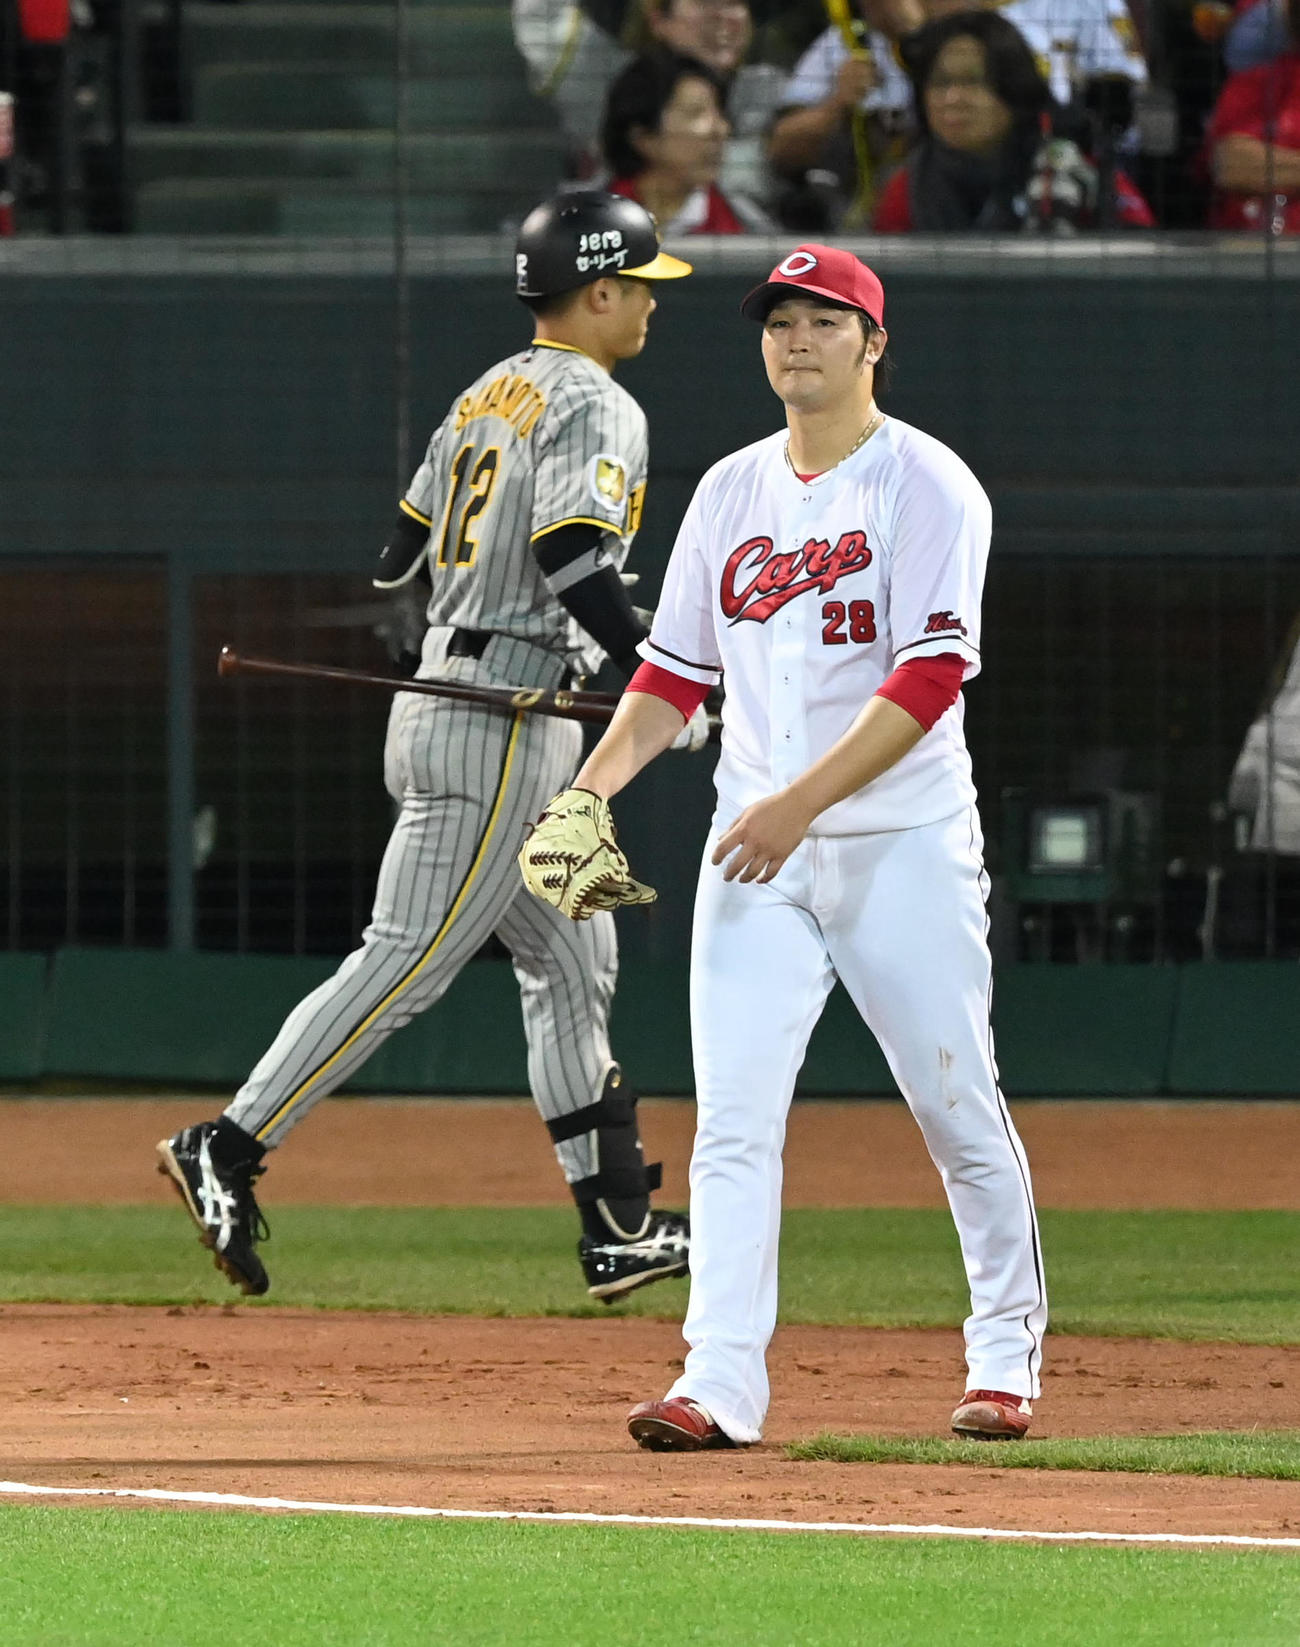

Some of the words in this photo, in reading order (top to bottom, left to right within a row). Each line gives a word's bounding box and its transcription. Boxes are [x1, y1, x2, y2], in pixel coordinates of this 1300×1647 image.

[778, 251, 818, 277] C
[436, 444, 502, 569] 12
[720, 530, 873, 628] Carp
[822, 599, 877, 645] 28
